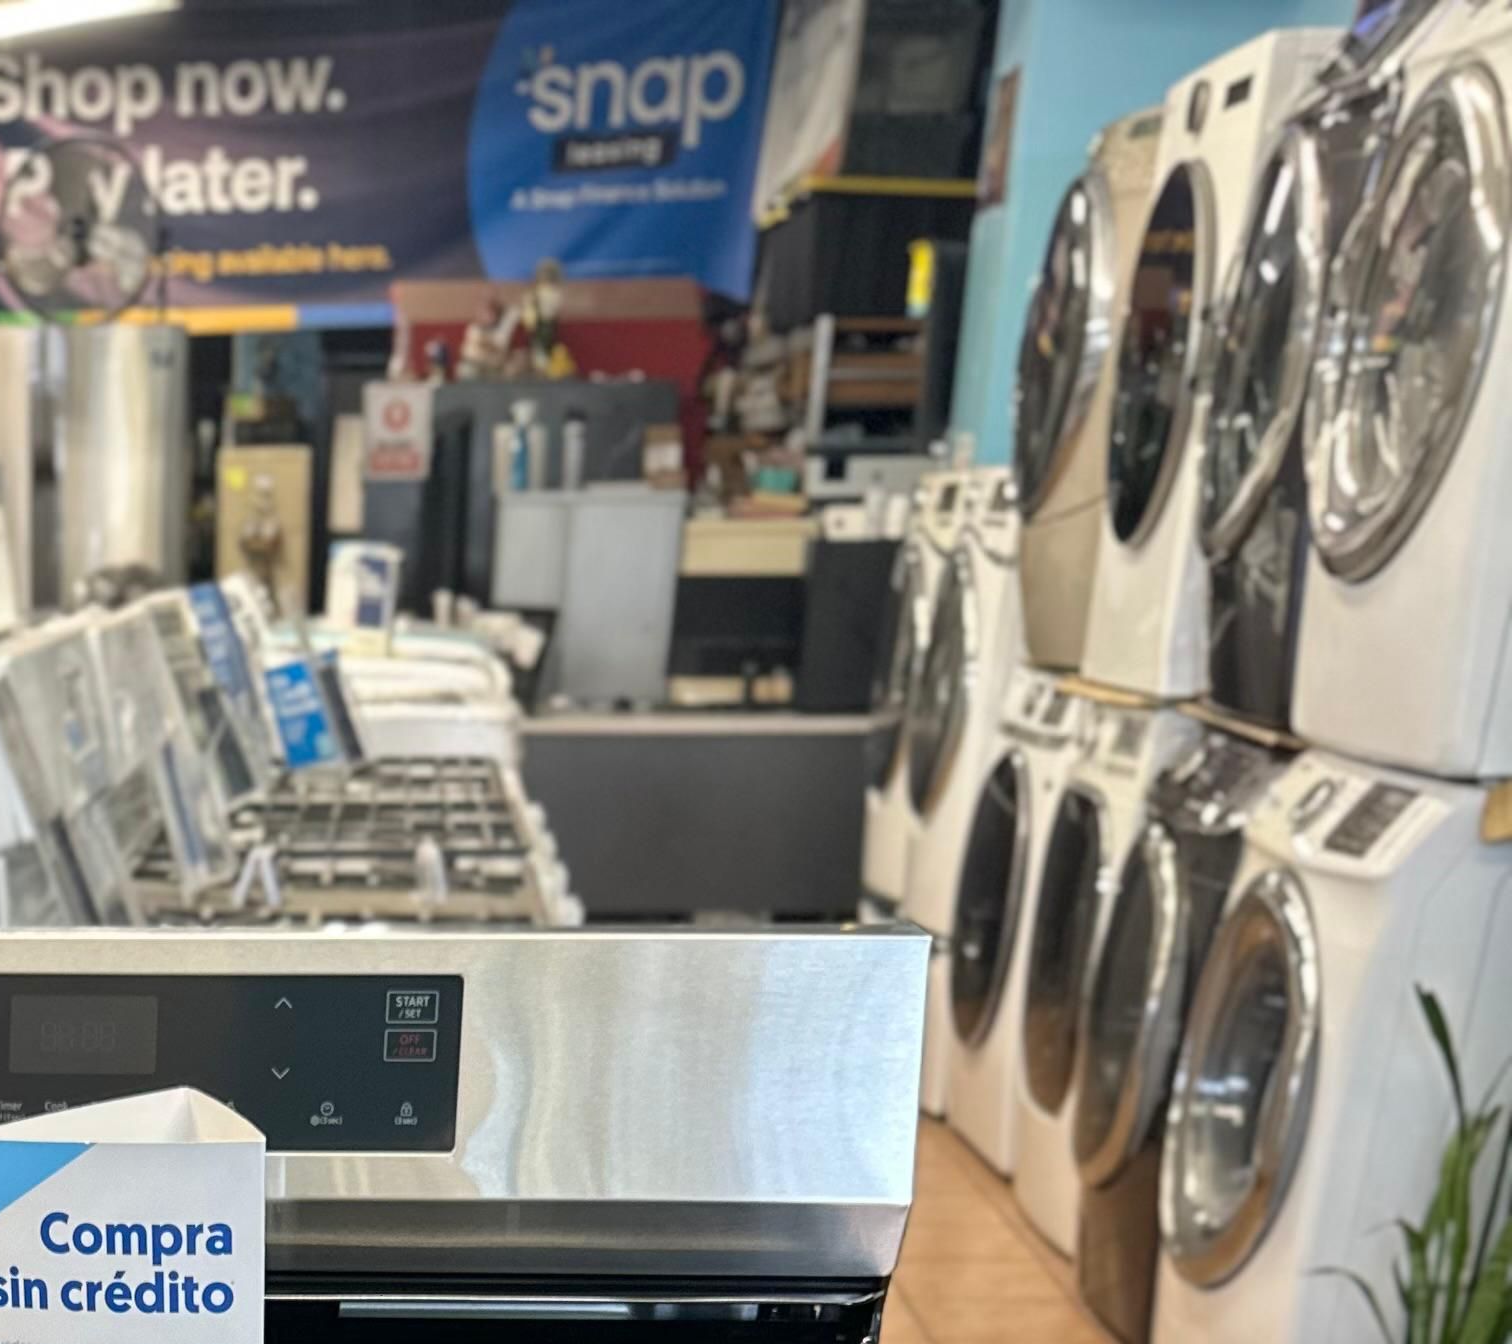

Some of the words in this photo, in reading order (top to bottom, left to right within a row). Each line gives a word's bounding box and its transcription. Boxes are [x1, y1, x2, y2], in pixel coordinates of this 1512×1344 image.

[177, 56, 346, 116] now.
[528, 51, 745, 149] snap
[395, 996, 430, 1007] START
[39, 1211, 233, 1265] Compra
[60, 1269, 235, 1315] crédito
